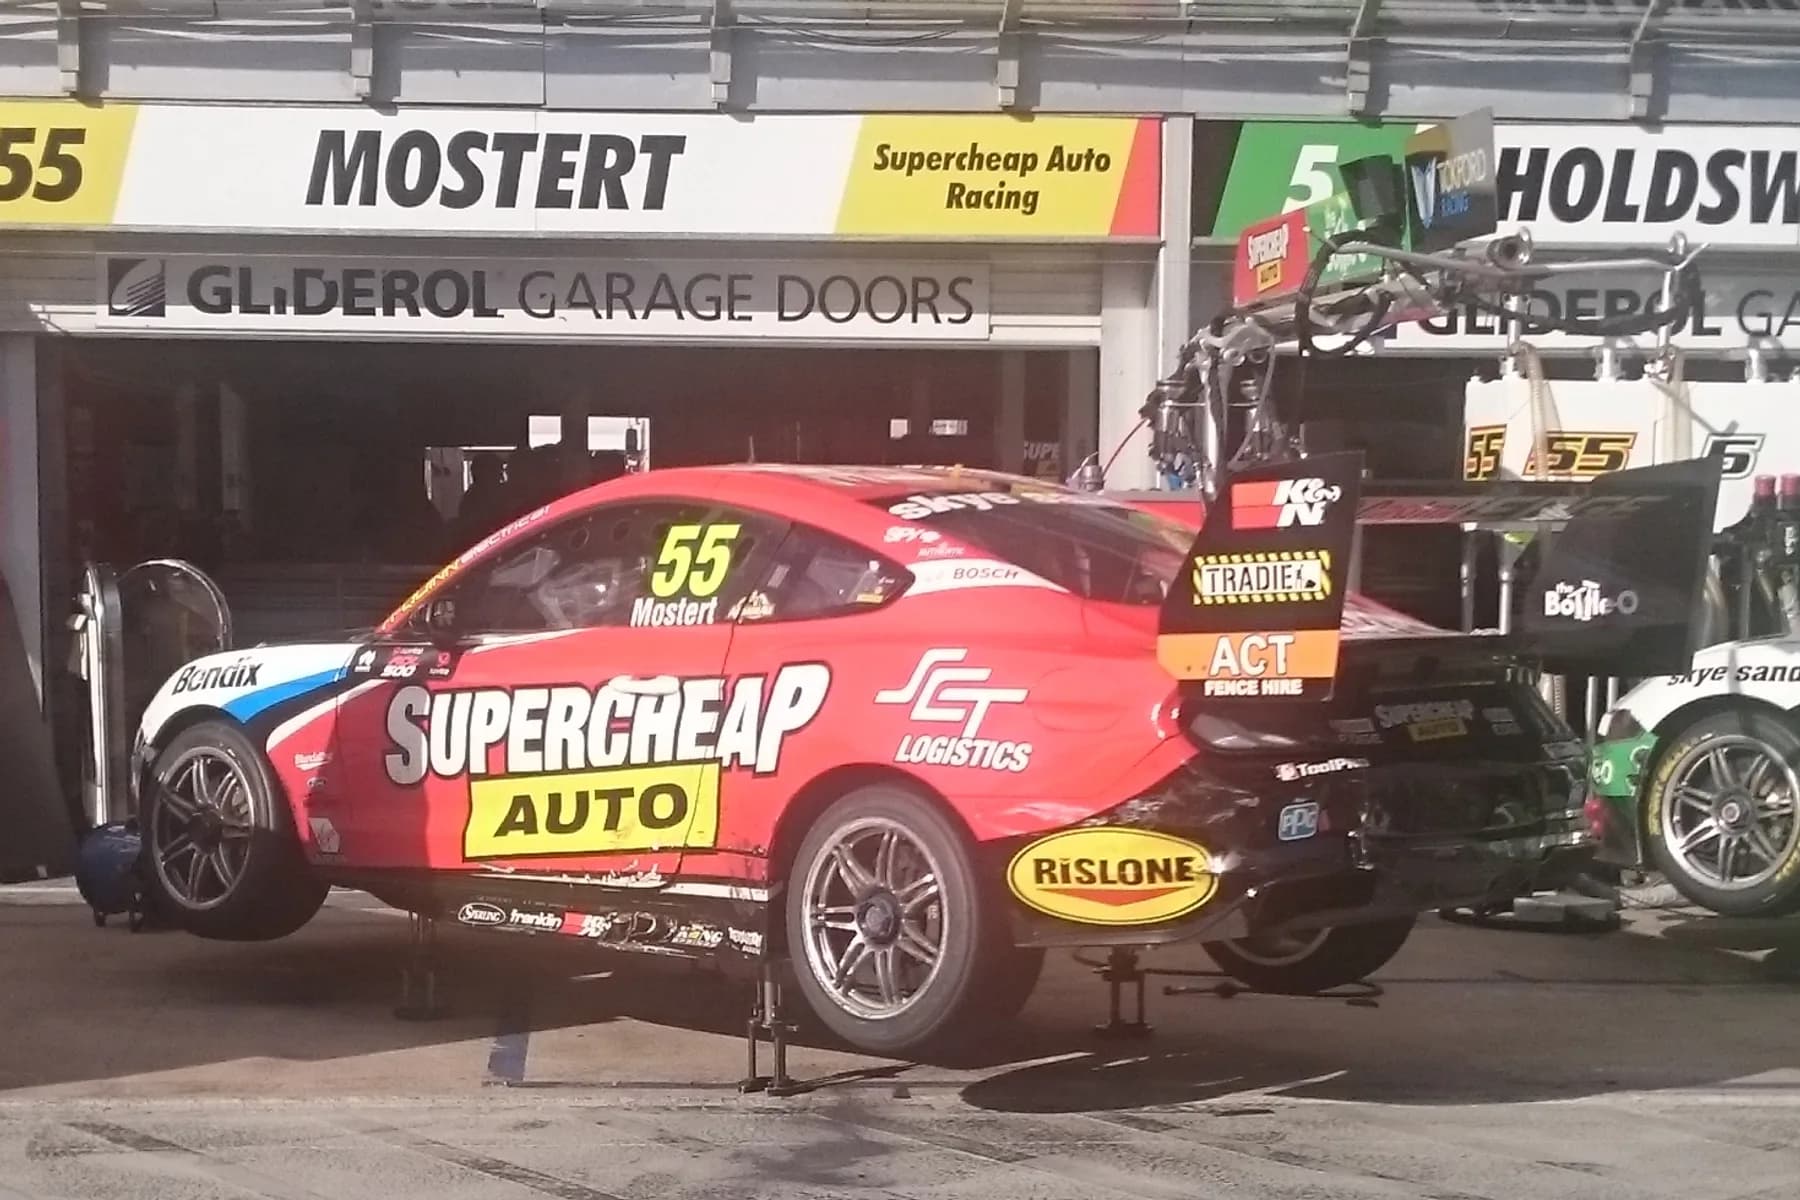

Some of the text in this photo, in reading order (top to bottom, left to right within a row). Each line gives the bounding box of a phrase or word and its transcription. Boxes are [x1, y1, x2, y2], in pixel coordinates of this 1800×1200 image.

[0, 127, 86, 203] 55
[305, 130, 687, 211] MOSTERT
[873, 143, 1112, 178] Supercheap Auto
[945, 182, 1039, 216] Racing
[187, 265, 974, 325] GLIDEROL GARAGE DOORS
[1466, 430, 1505, 479] 55
[1523, 434, 1634, 476] 55
[652, 524, 741, 597] 55
[953, 567, 1019, 580] BOSCH
[1206, 564, 1293, 593] TRADIE
[630, 597, 718, 627] Mostert
[172, 657, 264, 695] Bendix
[1208, 635, 1295, 677] ACT
[873, 647, 1030, 740] SCT
[1204, 679, 1304, 697] FENCE HIRE
[385, 661, 831, 787] SUPERCHEAP
[894, 734, 1033, 773] LOGISTICS
[493, 783, 688, 838] AUTO
